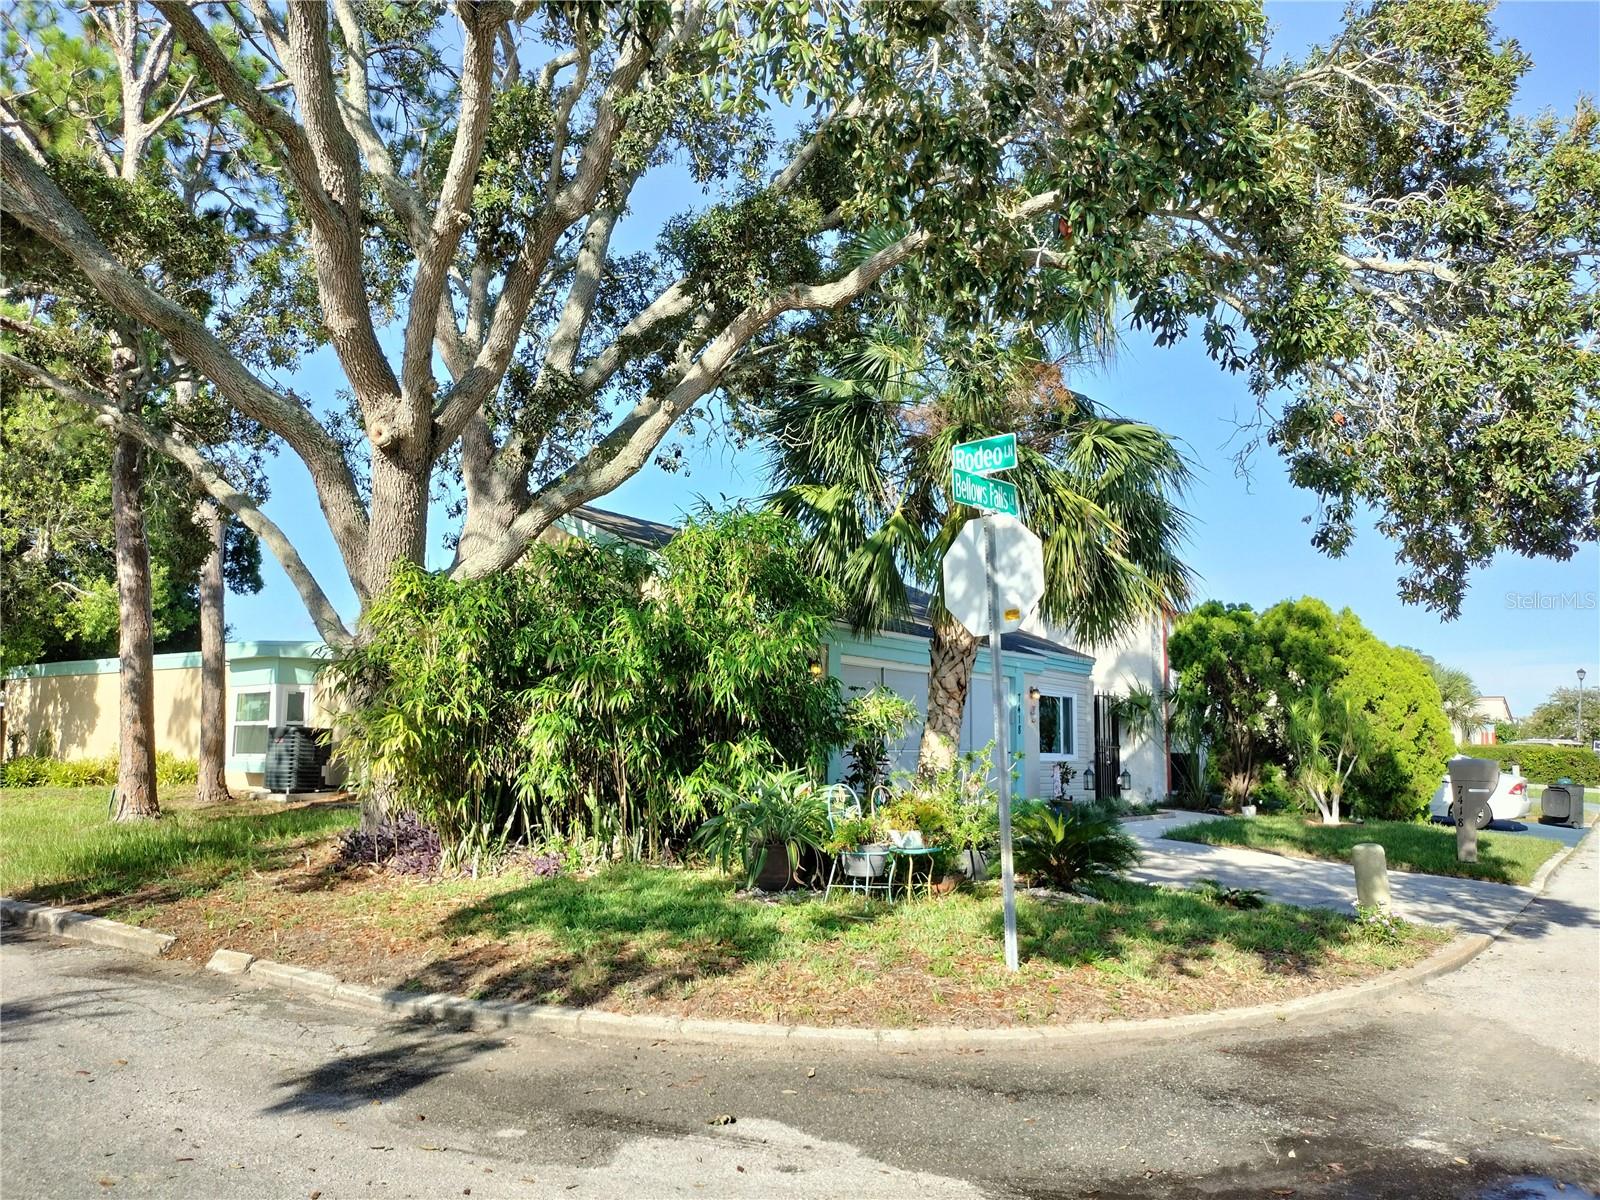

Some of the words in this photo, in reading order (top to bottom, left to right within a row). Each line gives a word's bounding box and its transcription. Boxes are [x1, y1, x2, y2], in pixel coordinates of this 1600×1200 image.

[955, 446, 1003, 471] Rodeo
[1004, 444, 1013, 458] LN
[955, 473, 988, 505] Bellows
[989, 482, 1009, 510] Falls
